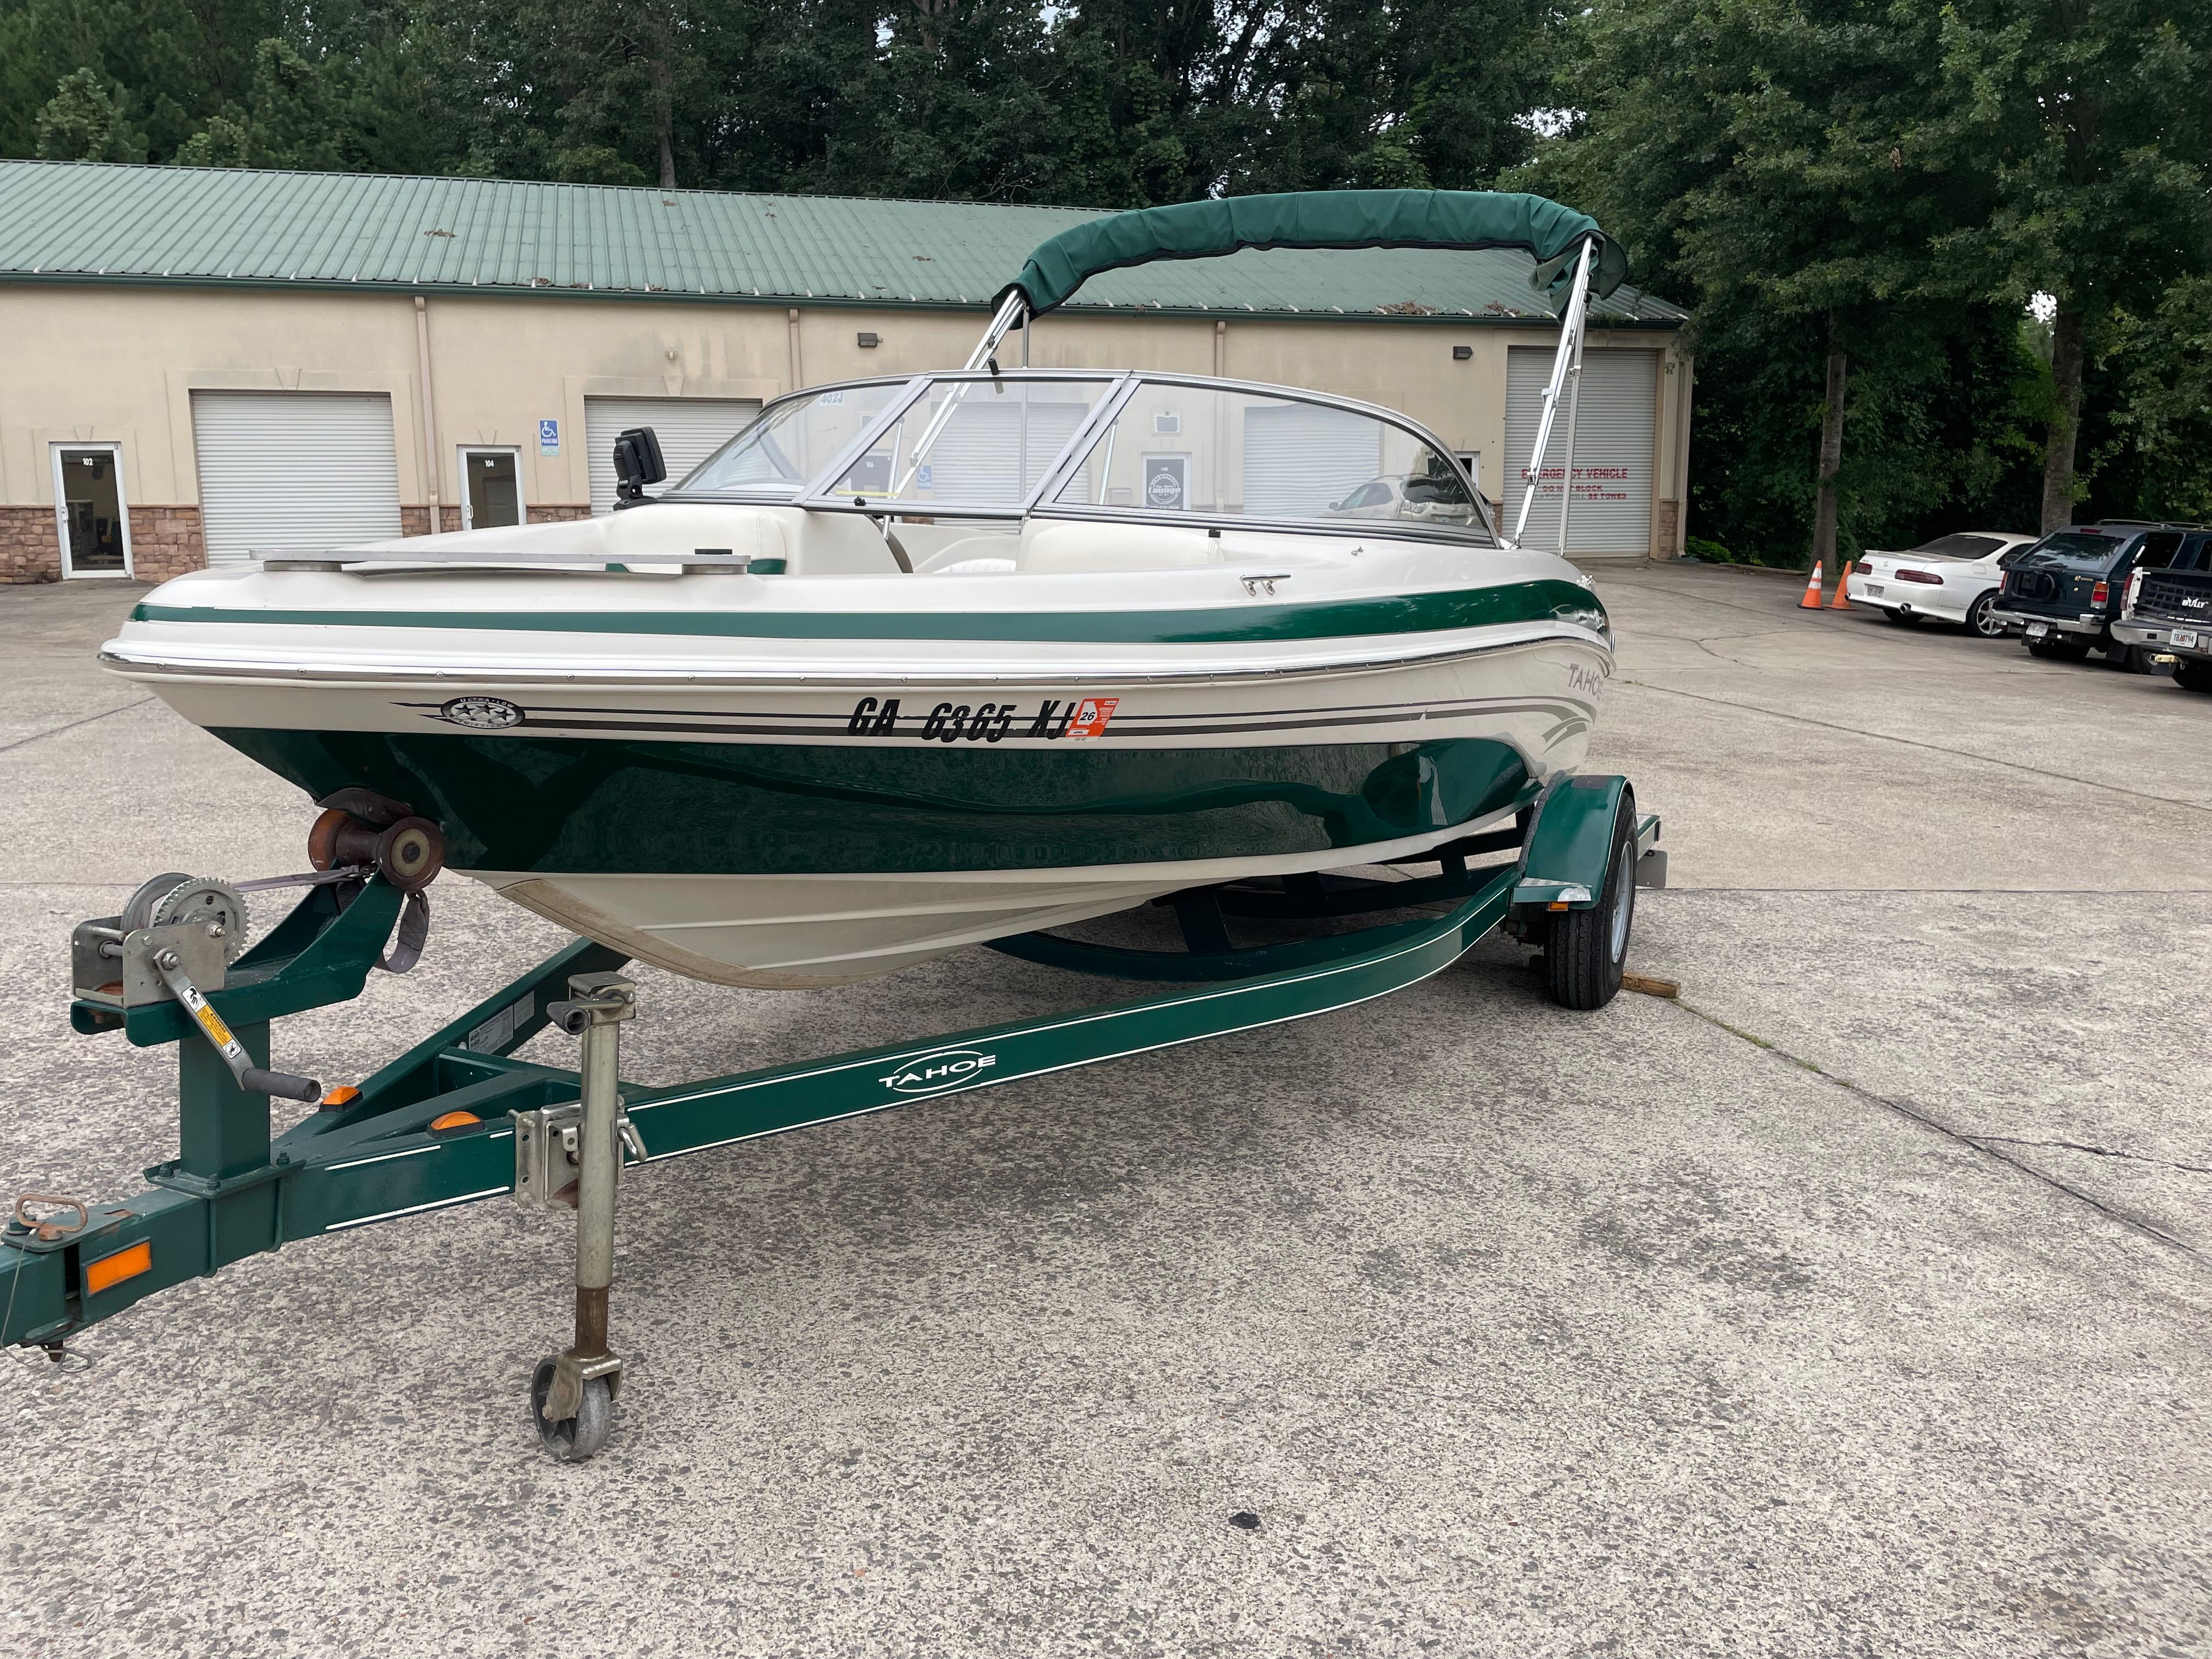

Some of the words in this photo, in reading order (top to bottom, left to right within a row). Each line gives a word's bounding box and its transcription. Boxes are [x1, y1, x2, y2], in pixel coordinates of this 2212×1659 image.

[821, 392, 843, 404] 4023
[1587, 468, 1628, 479] VEHICLE
[2182, 596, 2205, 608] BULLY
[496, 700, 515, 709] LOW
[847, 697, 901, 736] GA
[921, 702, 1018, 743] 6365
[1026, 700, 1077, 740] XJ
[1079, 712, 1096, 721] 26
[878, 1054, 996, 1088] TAHOE
